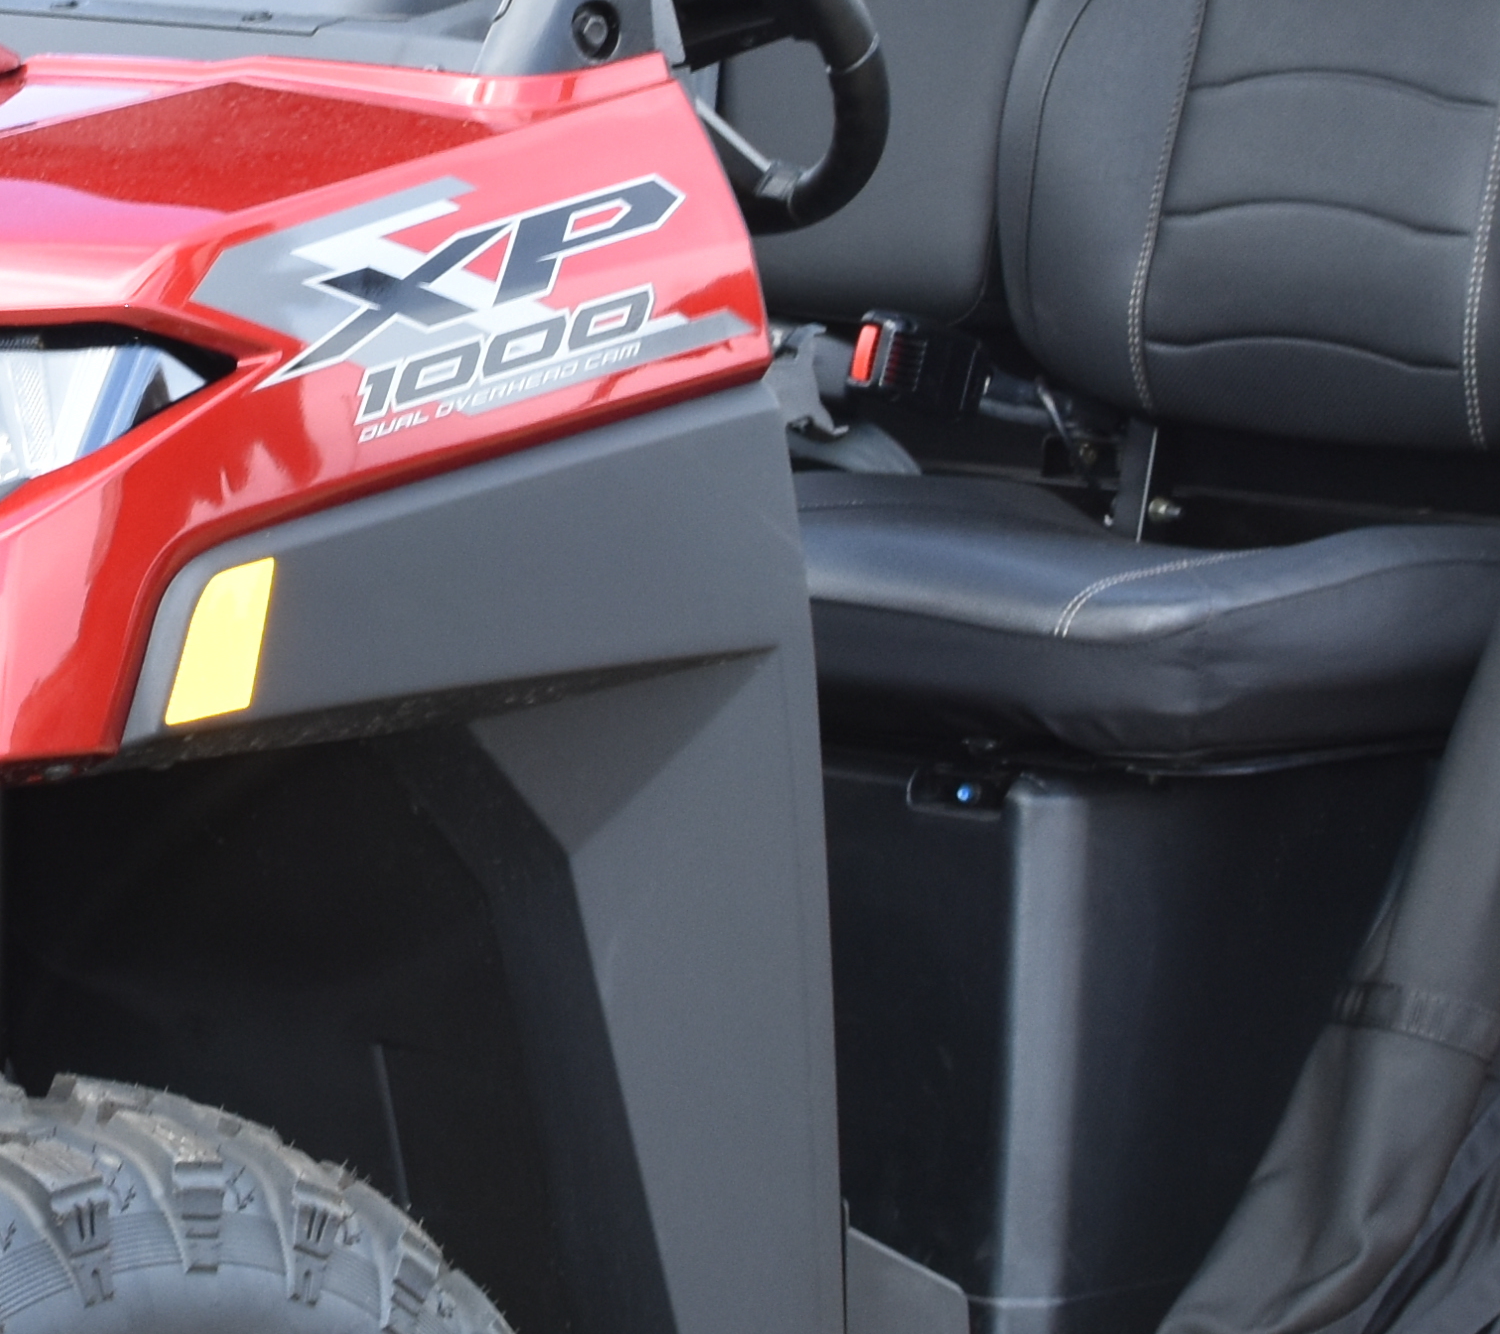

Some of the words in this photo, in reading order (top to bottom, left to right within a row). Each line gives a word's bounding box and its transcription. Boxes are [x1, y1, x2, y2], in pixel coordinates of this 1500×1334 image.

[253, 173, 686, 391] XP
[355, 284, 655, 425] 1000
[357, 412, 428, 443] DUAL
[436, 361, 578, 416] OVERHEAD
[583, 341, 641, 378] CAM
